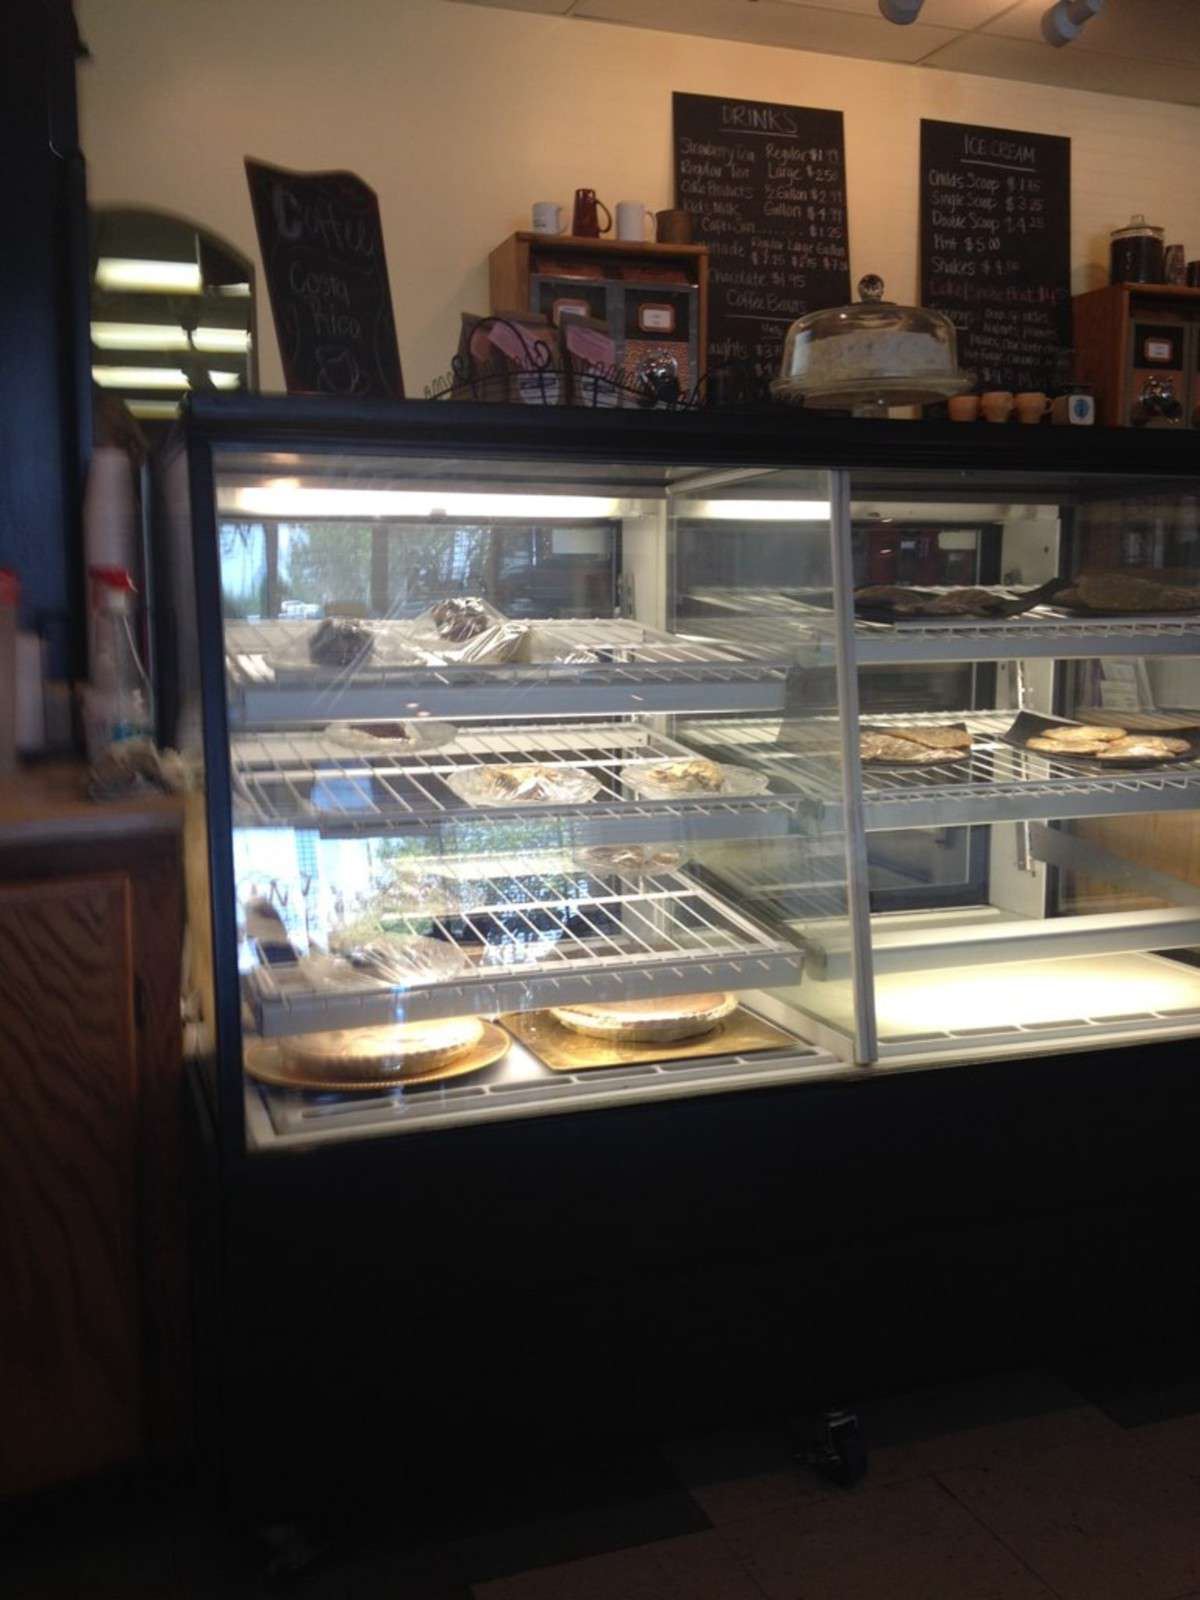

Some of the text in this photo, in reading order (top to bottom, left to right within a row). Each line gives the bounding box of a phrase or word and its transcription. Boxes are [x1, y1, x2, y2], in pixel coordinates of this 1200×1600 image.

[721, 104, 799, 135] DRINKS
[963, 133, 1037, 164] ICE CREAM
[768, 161, 804, 186] Large
